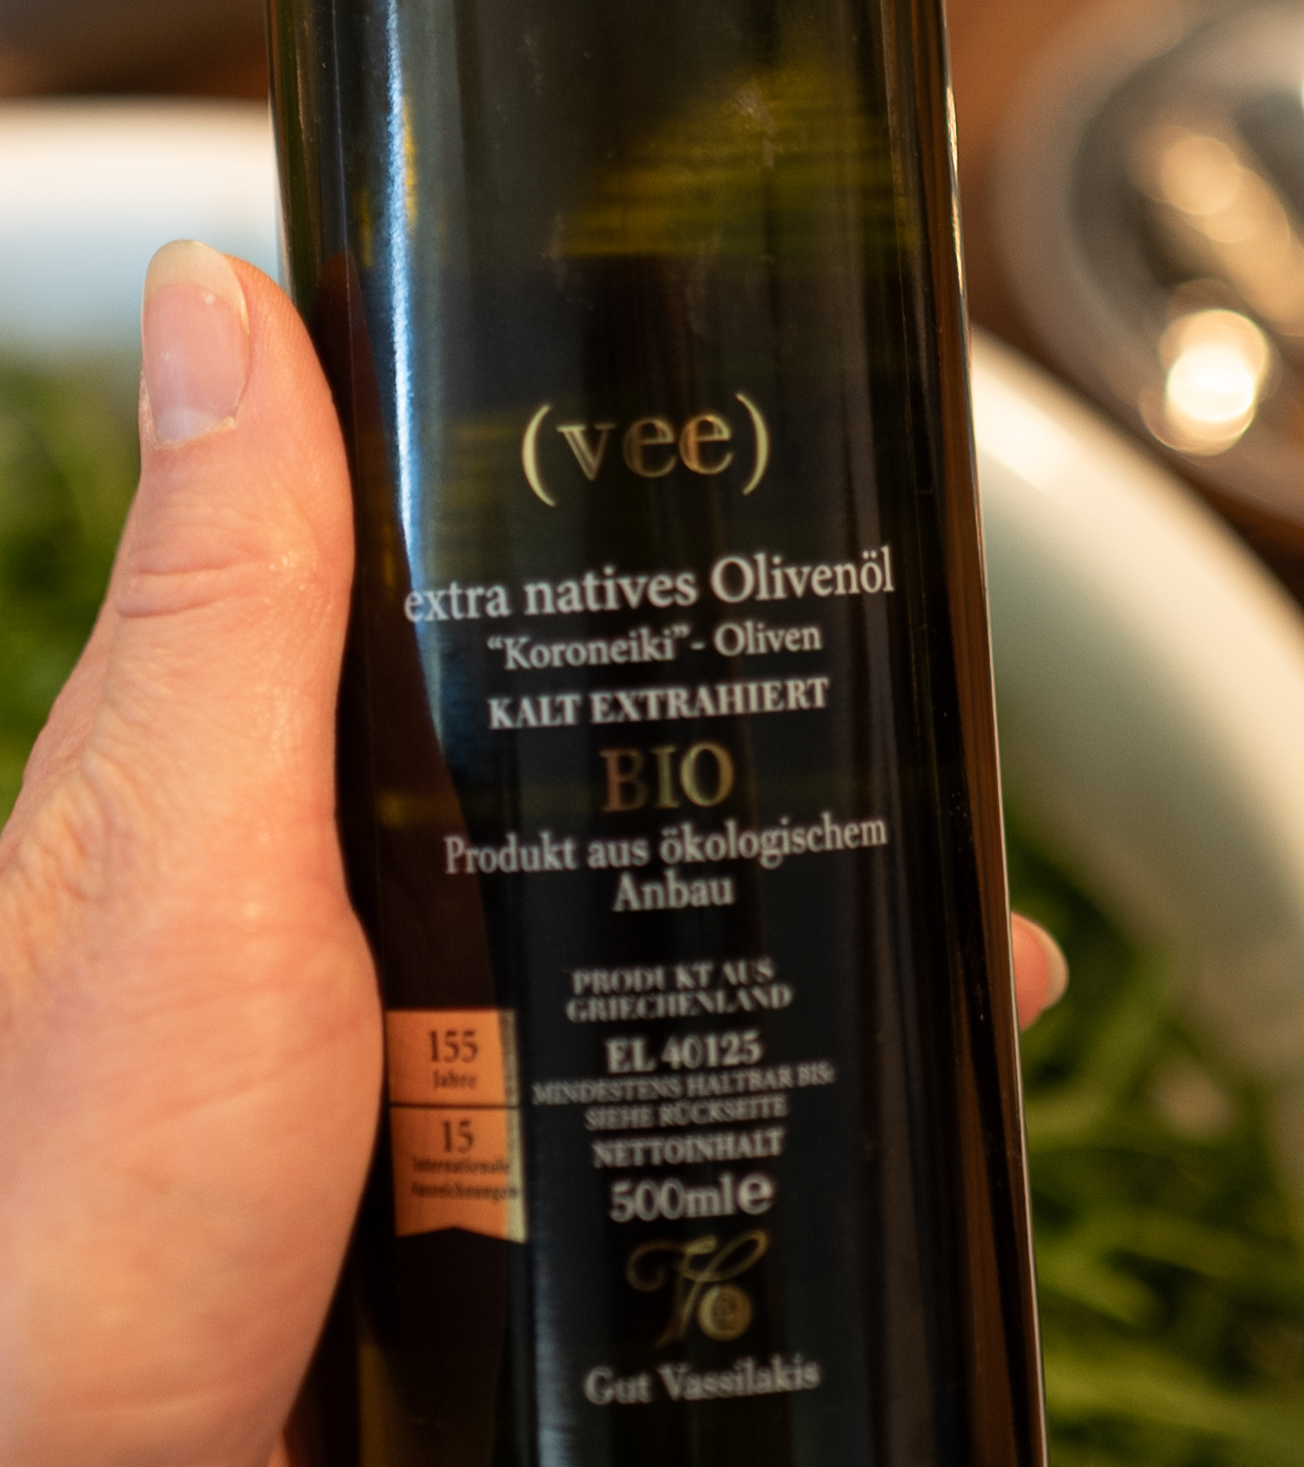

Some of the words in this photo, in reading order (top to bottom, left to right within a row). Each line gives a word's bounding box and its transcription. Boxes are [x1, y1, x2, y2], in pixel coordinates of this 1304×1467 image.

[521, 392, 770, 507] (vee)
[404, 581, 511, 623] extra
[524, 564, 698, 616] natives
[710, 544, 895, 604] Olivenöl
[713, 619, 823, 658] Oliven
[487, 693, 581, 730] KALT
[588, 676, 830, 724] EXTRAHIERT
[599, 742, 736, 814] BIO
[444, 833, 577, 874] Produkt
[587, 837, 649, 868] aus
[659, 812, 889, 869] ökologischem
[613, 870, 734, 912] Anbau
[570, 962, 716, 996] PRODUKT
[720, 956, 776, 987] AUS
[566, 983, 793, 1023] GRIECHENLAND
[428, 1029, 480, 1064] 155
[604, 1035, 658, 1075] EL
[660, 1028, 765, 1071] 40125
[530, 1073, 684, 1106] MINDESTENS
[685, 1065, 795, 1099] HALTBAR
[584, 1104, 656, 1131] SIEHE
[658, 1092, 790, 1128] RÜCKSEITE
[441, 1119, 476, 1154] 15
[592, 1127, 784, 1167] NETTOINHALT
[583, 1365, 654, 1406] Gut
[655, 1353, 822, 1402] Vassilakis
